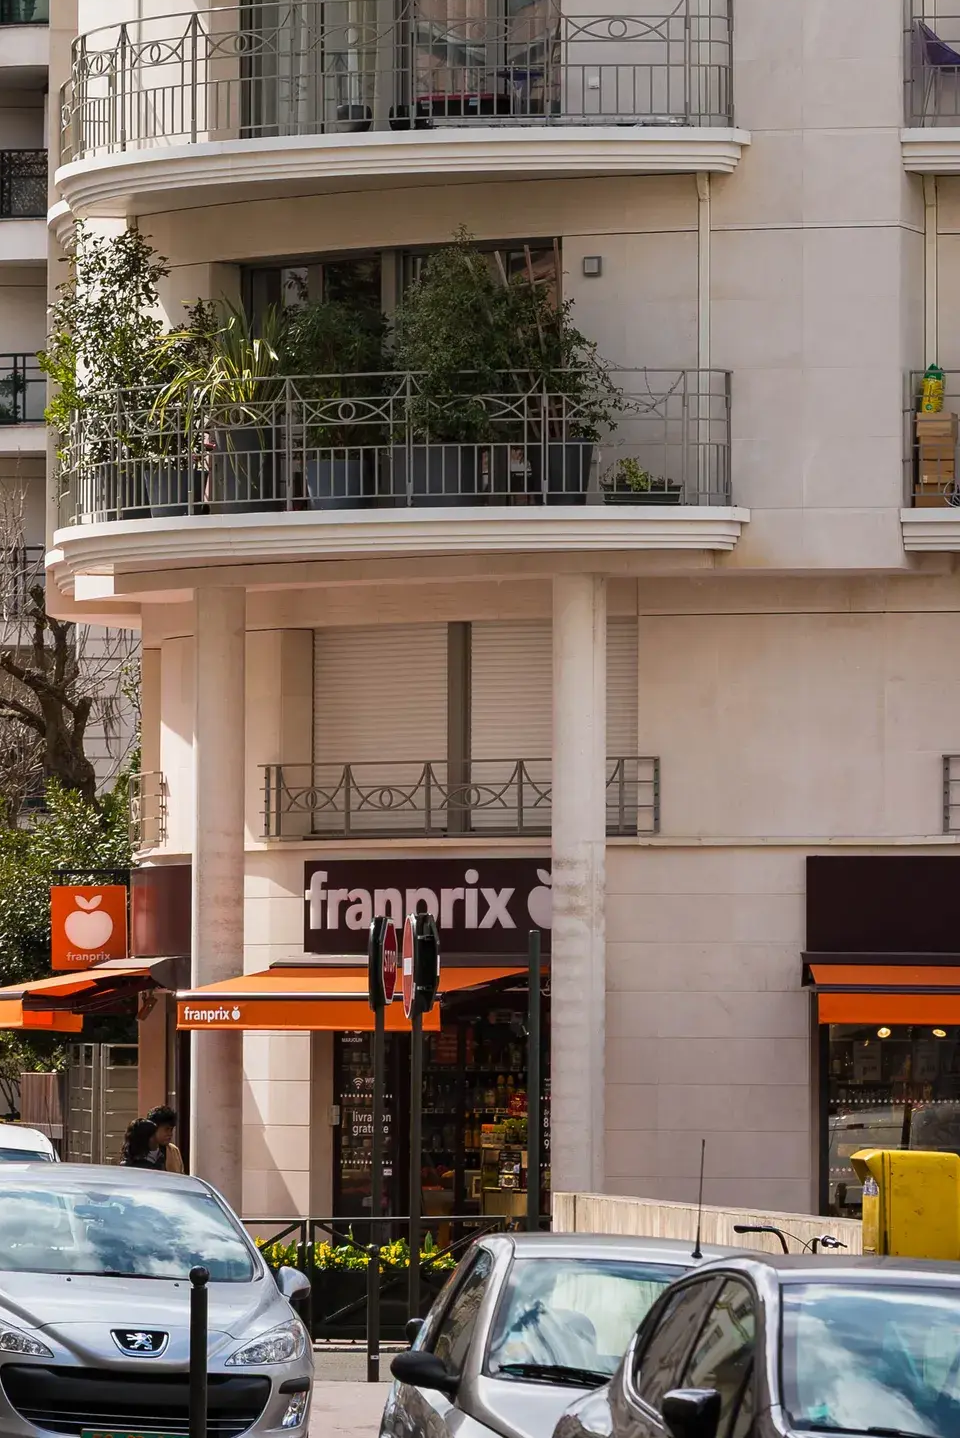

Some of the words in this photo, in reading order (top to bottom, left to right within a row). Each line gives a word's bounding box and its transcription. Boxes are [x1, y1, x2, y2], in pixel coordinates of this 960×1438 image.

[305, 869, 517, 930] franprix
[66, 951, 111, 962] franprix
[384, 949, 396, 973] STOP
[184, 1006, 230, 1023] franprix
